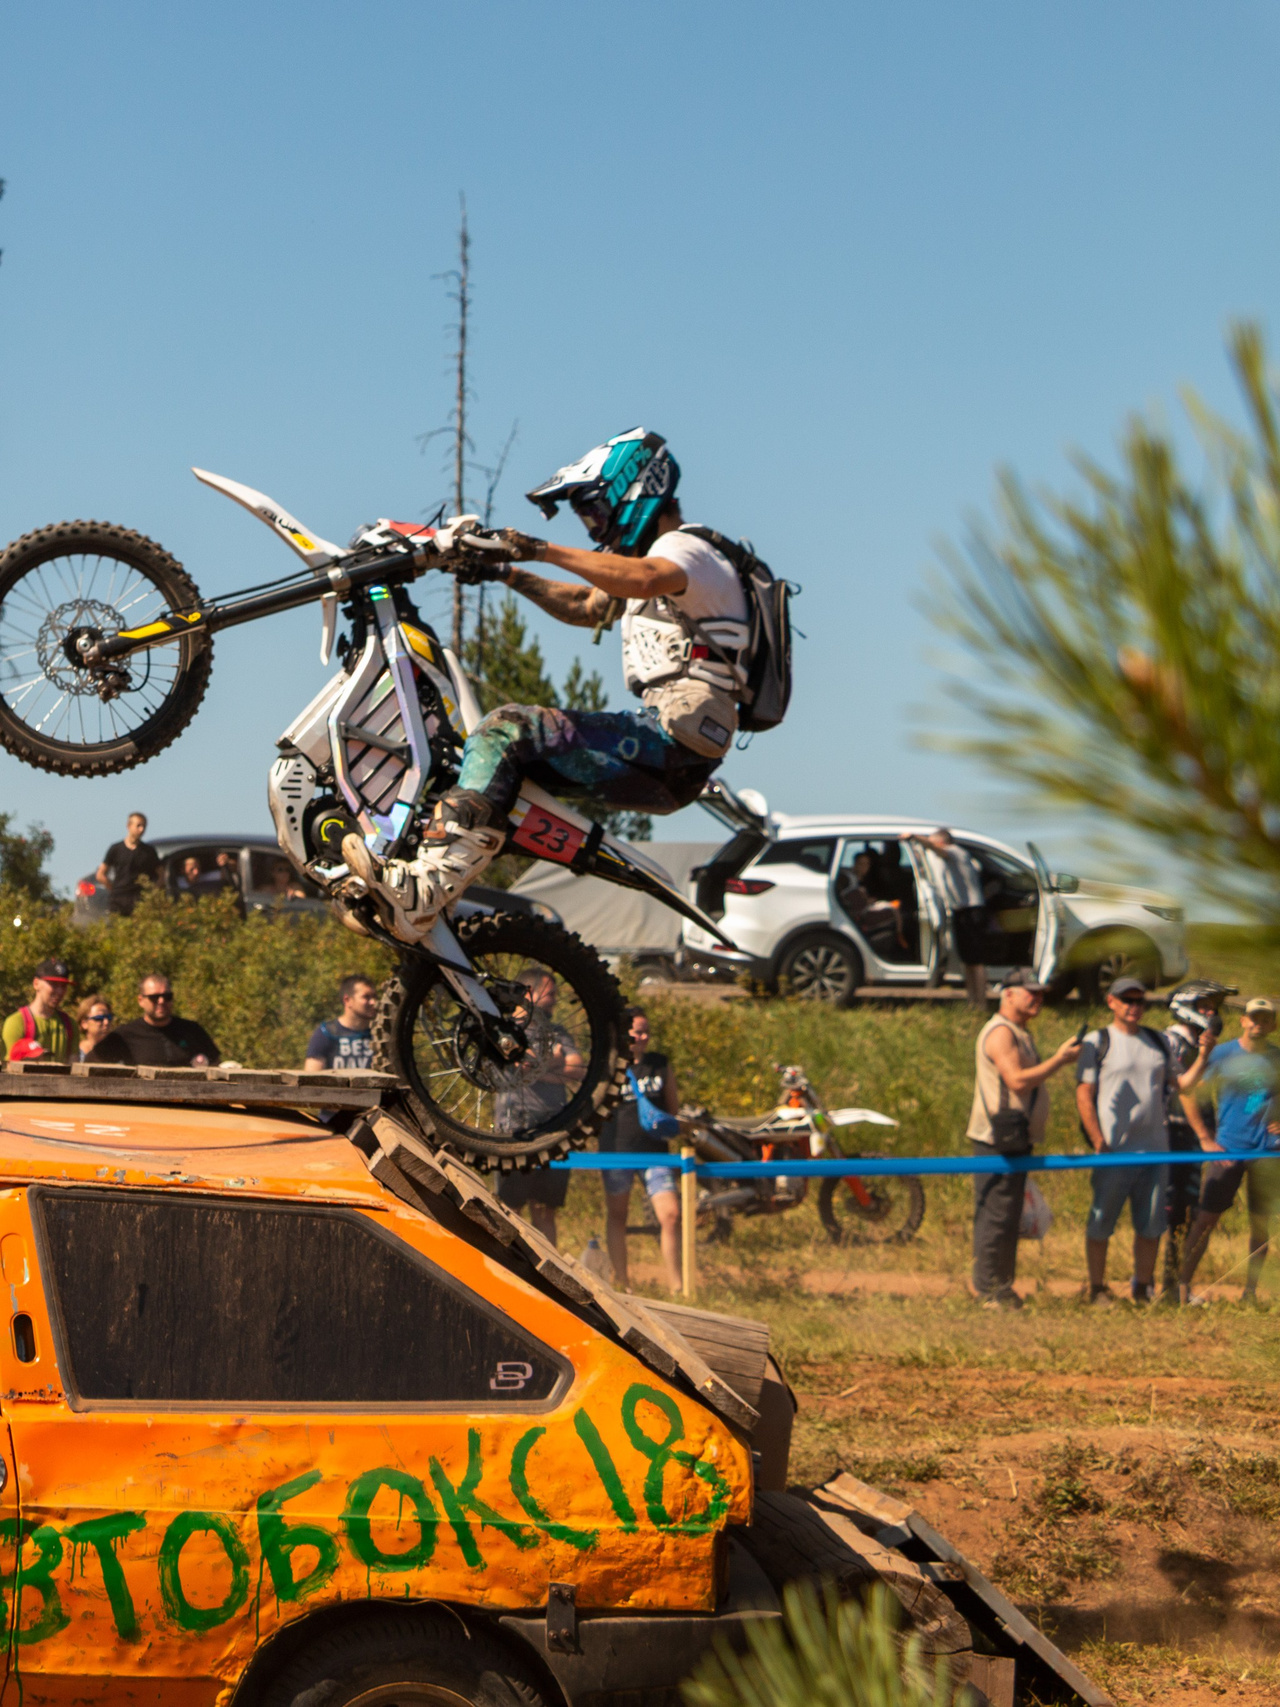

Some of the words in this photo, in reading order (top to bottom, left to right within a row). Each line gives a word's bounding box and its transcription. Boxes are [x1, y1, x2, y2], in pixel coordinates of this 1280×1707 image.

[605, 445, 652, 508] 100%
[528, 818, 570, 853] 23
[339, 1037, 374, 1057] BES
